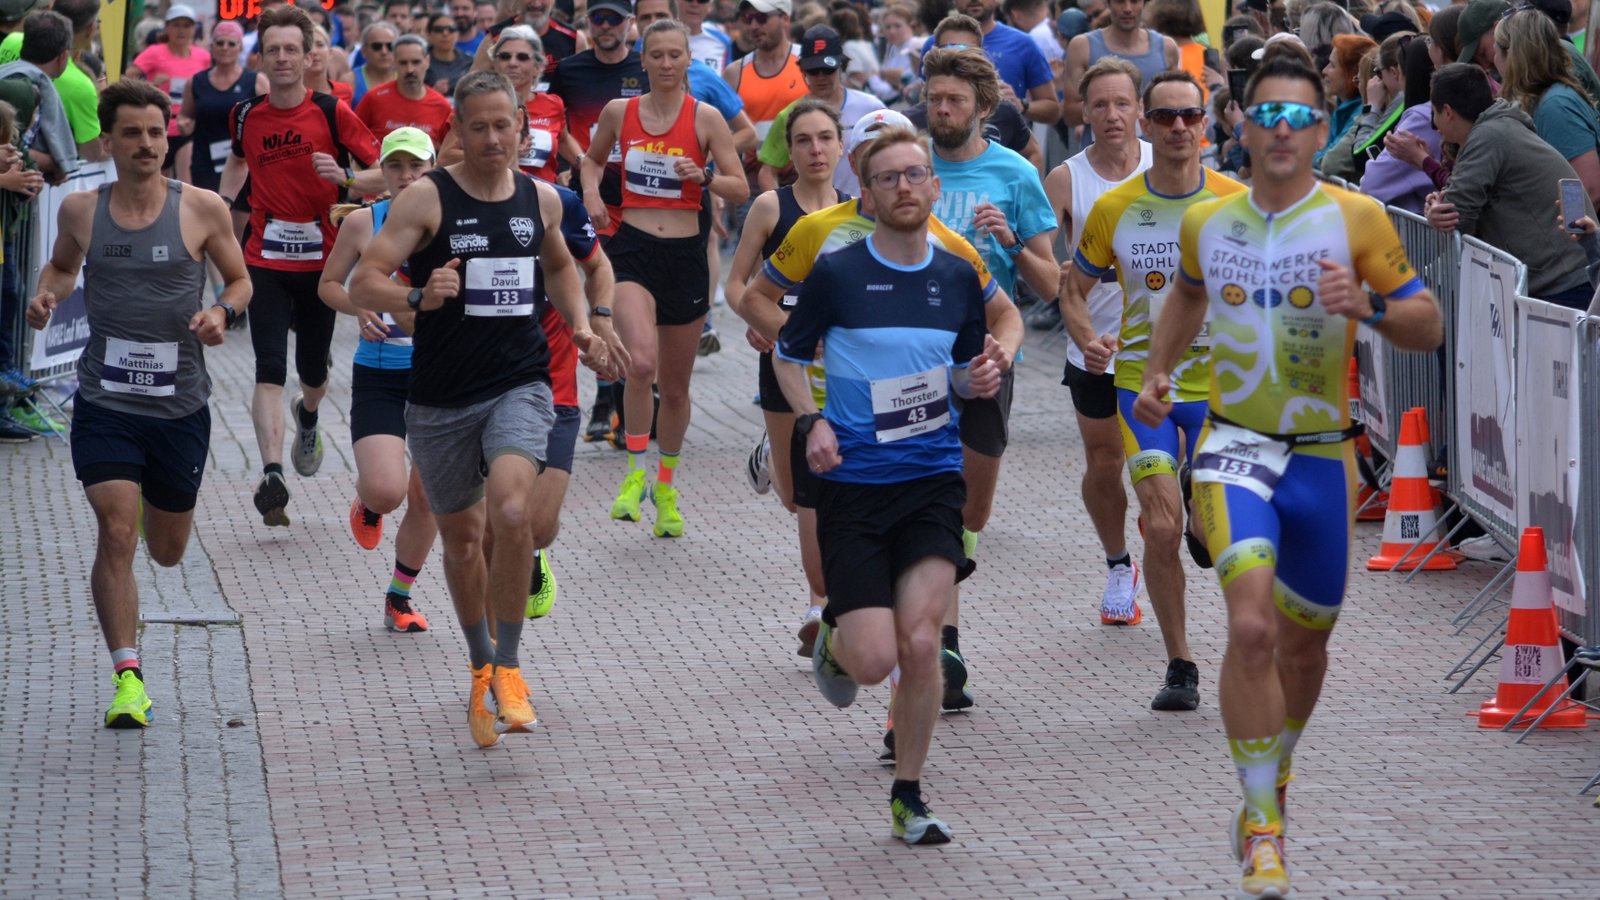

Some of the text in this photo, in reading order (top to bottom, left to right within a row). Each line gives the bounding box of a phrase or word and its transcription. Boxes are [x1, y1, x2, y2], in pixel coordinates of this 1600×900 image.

[262, 130, 302, 150] WiLa
[640, 165, 667, 175] Hanna
[645, 176, 660, 188] 14
[931, 191, 990, 219] WIM
[278, 233, 309, 241] Markus
[103, 245, 131, 257] RRC
[282, 243, 303, 253] 111
[1131, 257, 1175, 270] MÜHL
[491, 276, 520, 287] David
[492, 290, 519, 304] 133
[1199, 324, 1208, 336] 2
[118, 356, 164, 370] Matthias
[126, 371, 155, 386] 188
[890, 389, 939, 408] Thorsten
[907, 406, 928, 423] 43
[1219, 444, 1260, 460] André
[1218, 458, 1252, 476] 153
[1401, 520, 1419, 530] BIKE
[1401, 530, 1420, 539] RUN
[1514, 645, 1541, 655] SWIM
[1514, 654, 1541, 666] BIKE
